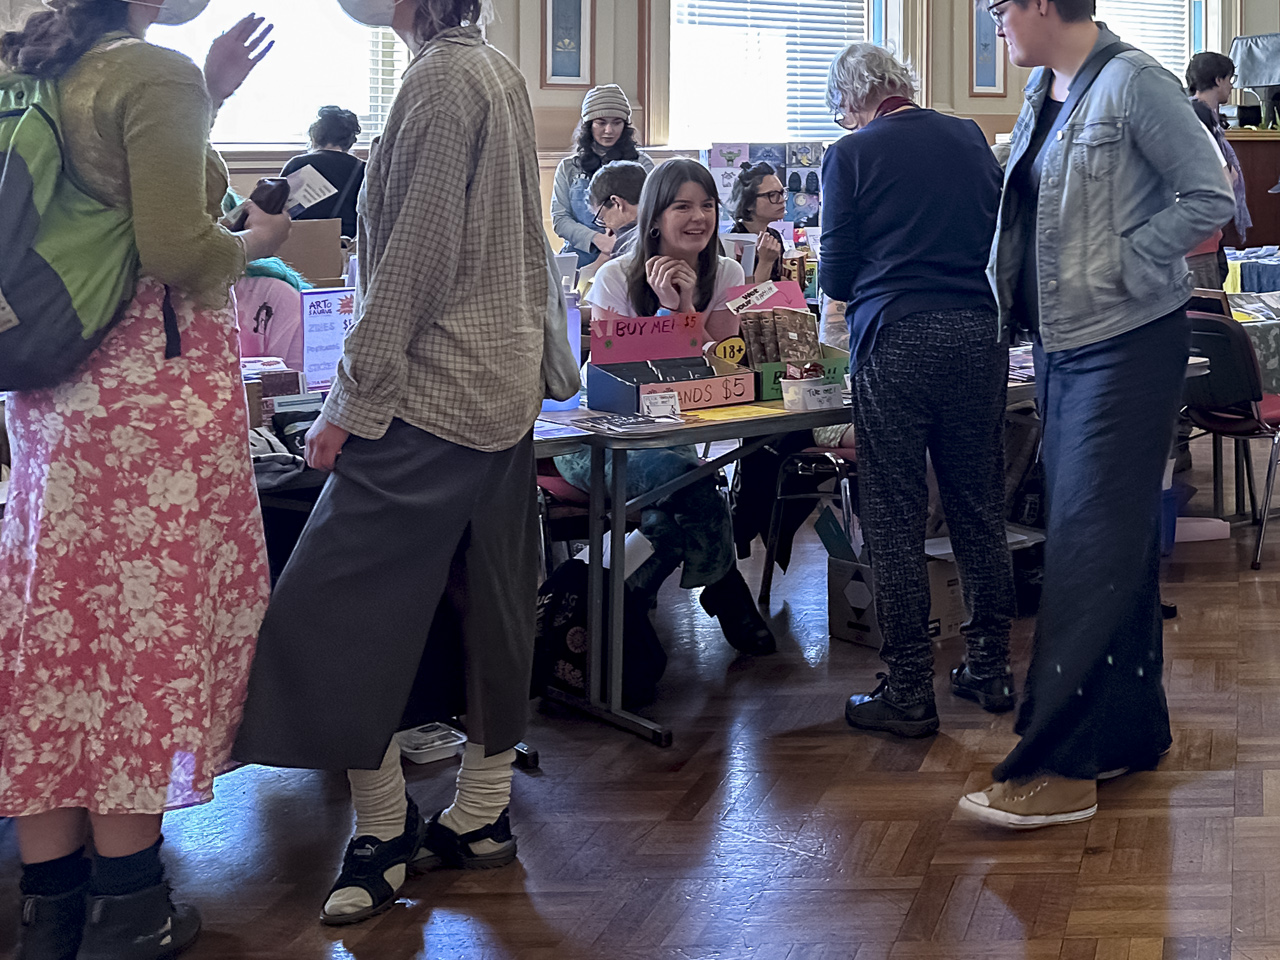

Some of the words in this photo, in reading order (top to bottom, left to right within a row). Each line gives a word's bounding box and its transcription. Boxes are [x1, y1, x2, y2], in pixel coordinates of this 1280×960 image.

[742, 288, 759, 301] Wet
[733, 299, 753, 314] your
[308, 322, 336, 333] ZINES
[616, 321, 647, 337] BUY
[651, 319, 675, 334] ME!
[684, 316, 696, 328] $5
[723, 344, 744, 359] 18+
[678, 384, 712, 405] ANDS
[722, 378, 745, 400] $5
